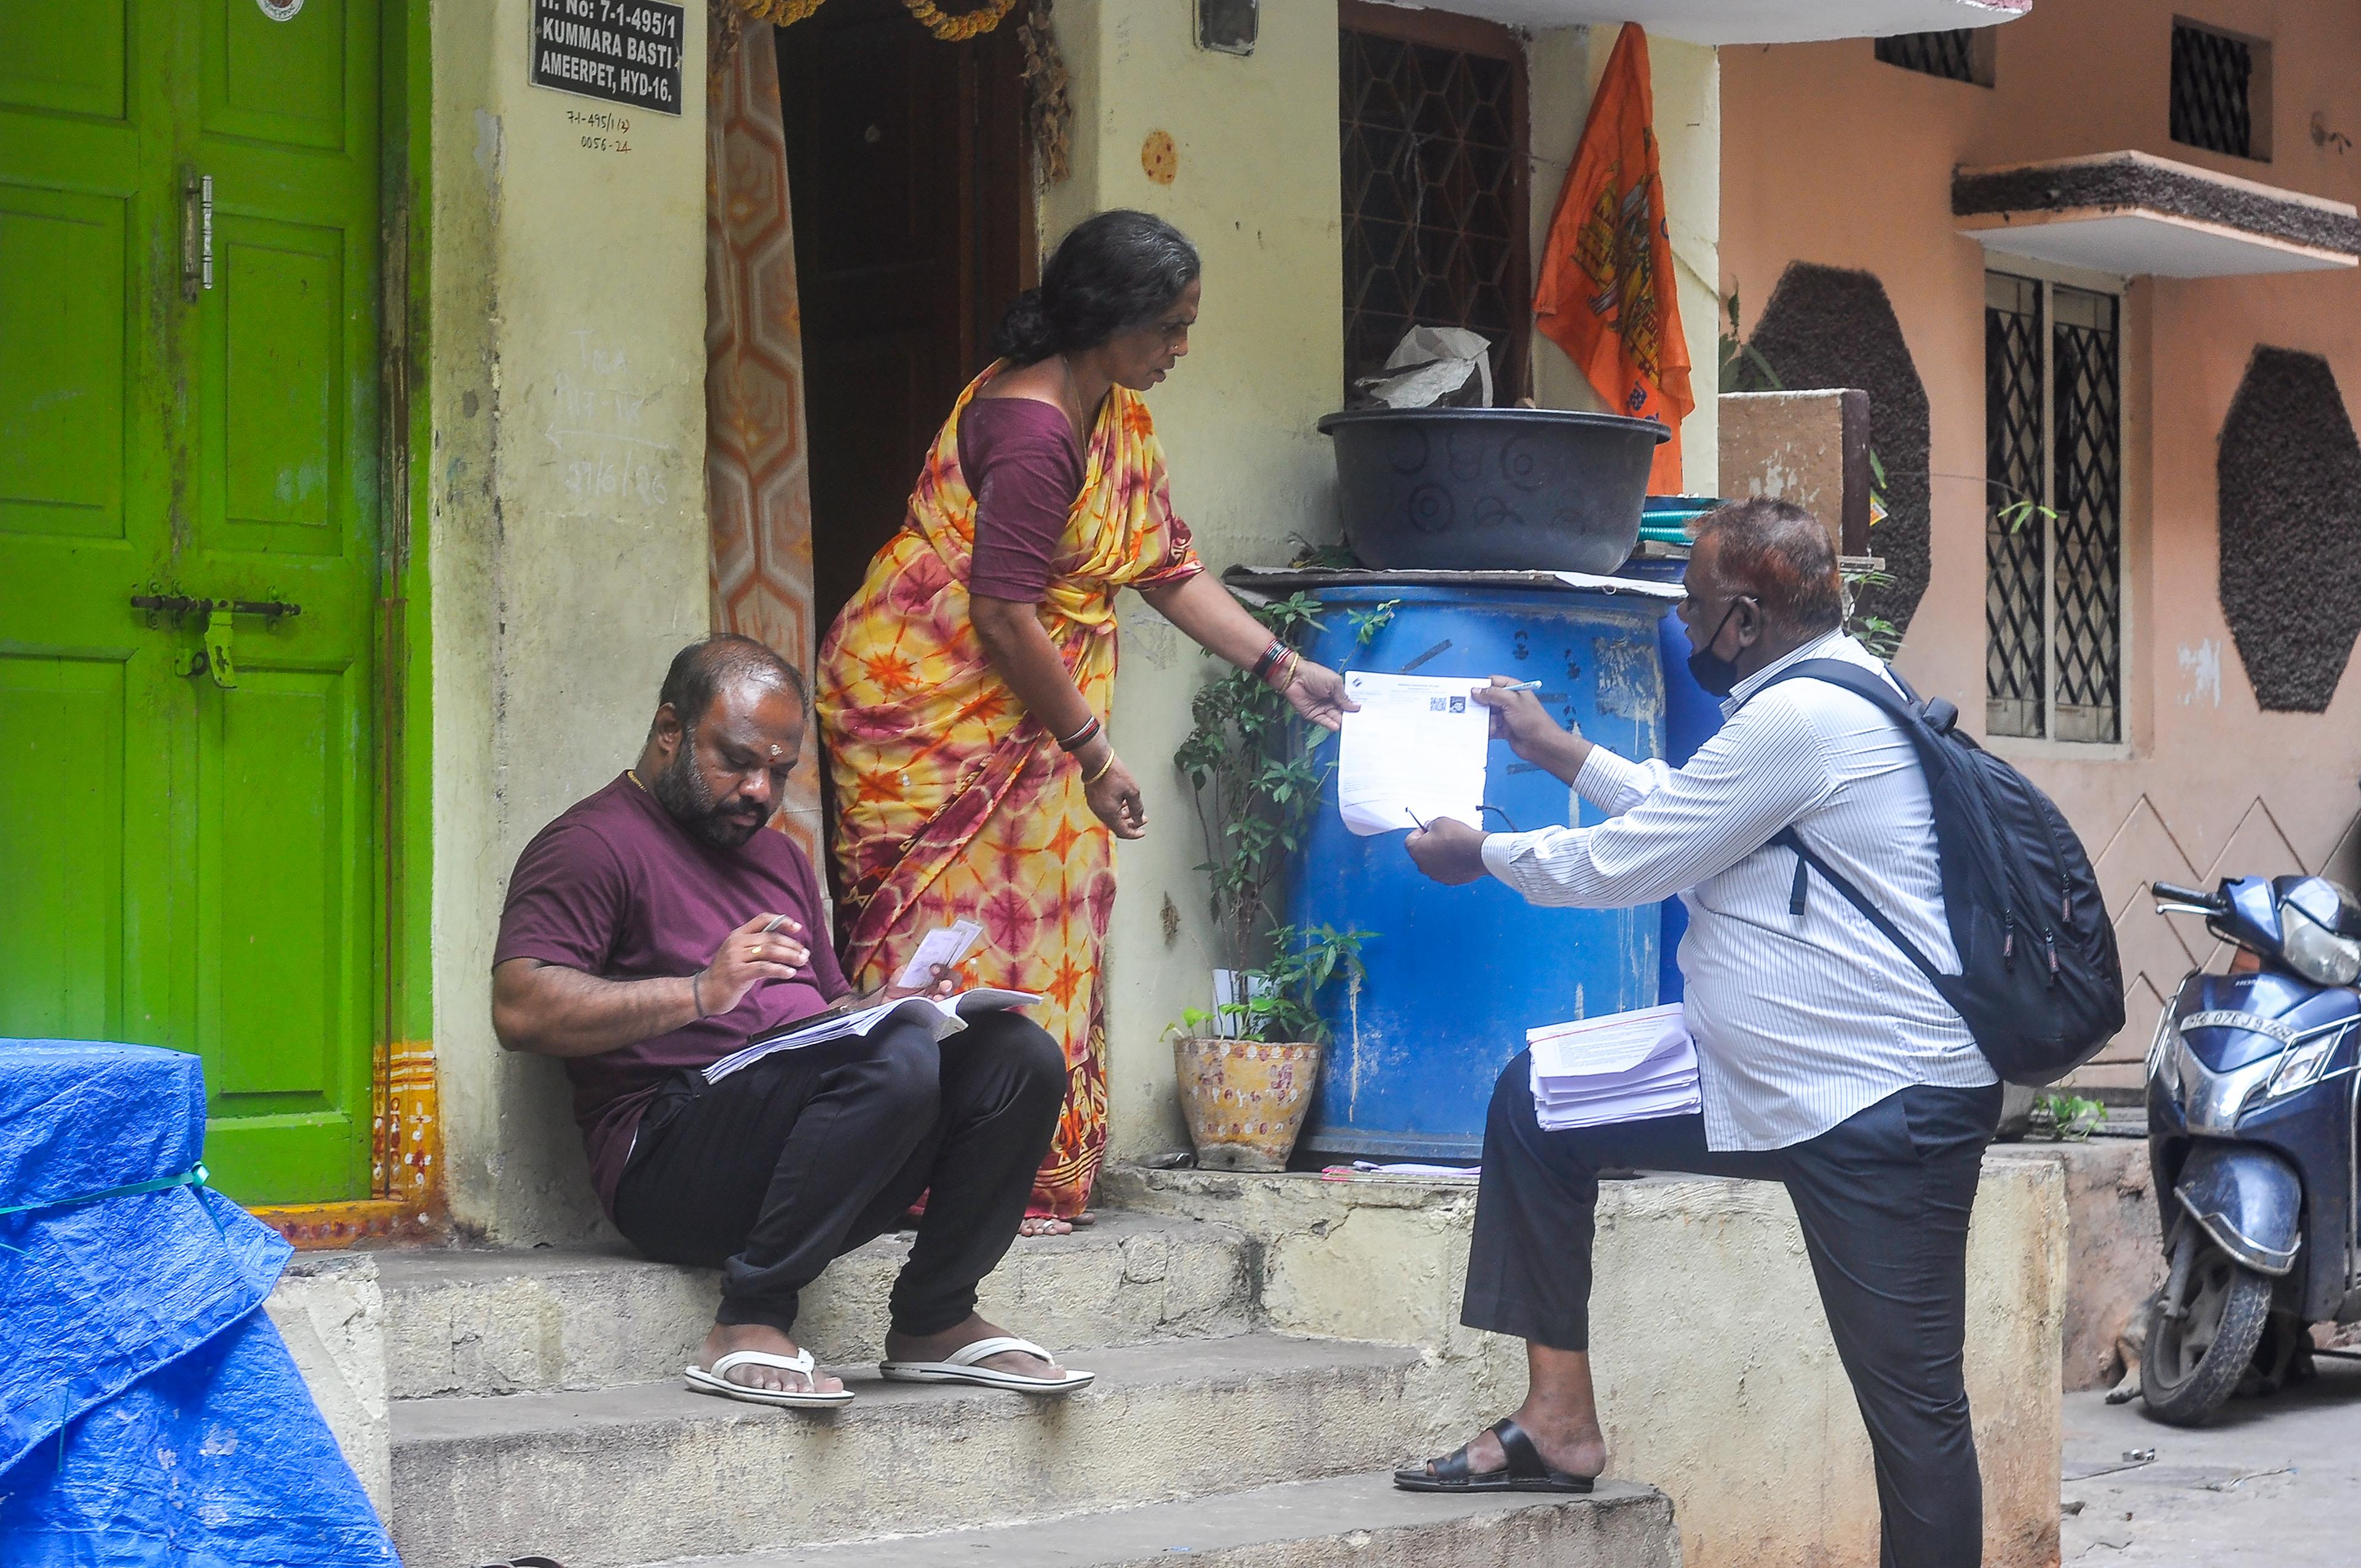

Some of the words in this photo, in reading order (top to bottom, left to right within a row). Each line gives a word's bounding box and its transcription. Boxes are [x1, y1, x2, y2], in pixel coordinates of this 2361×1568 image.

[542, 17, 622, 57] KUMMARA
[627, 37, 671, 68] BASTI
[566, 0, 594, 18] No:
[601, 0, 675, 38] 7-1-495/1
[541, 50, 616, 93] AMEERPET,
[620, 69, 672, 101] HYD-16.
